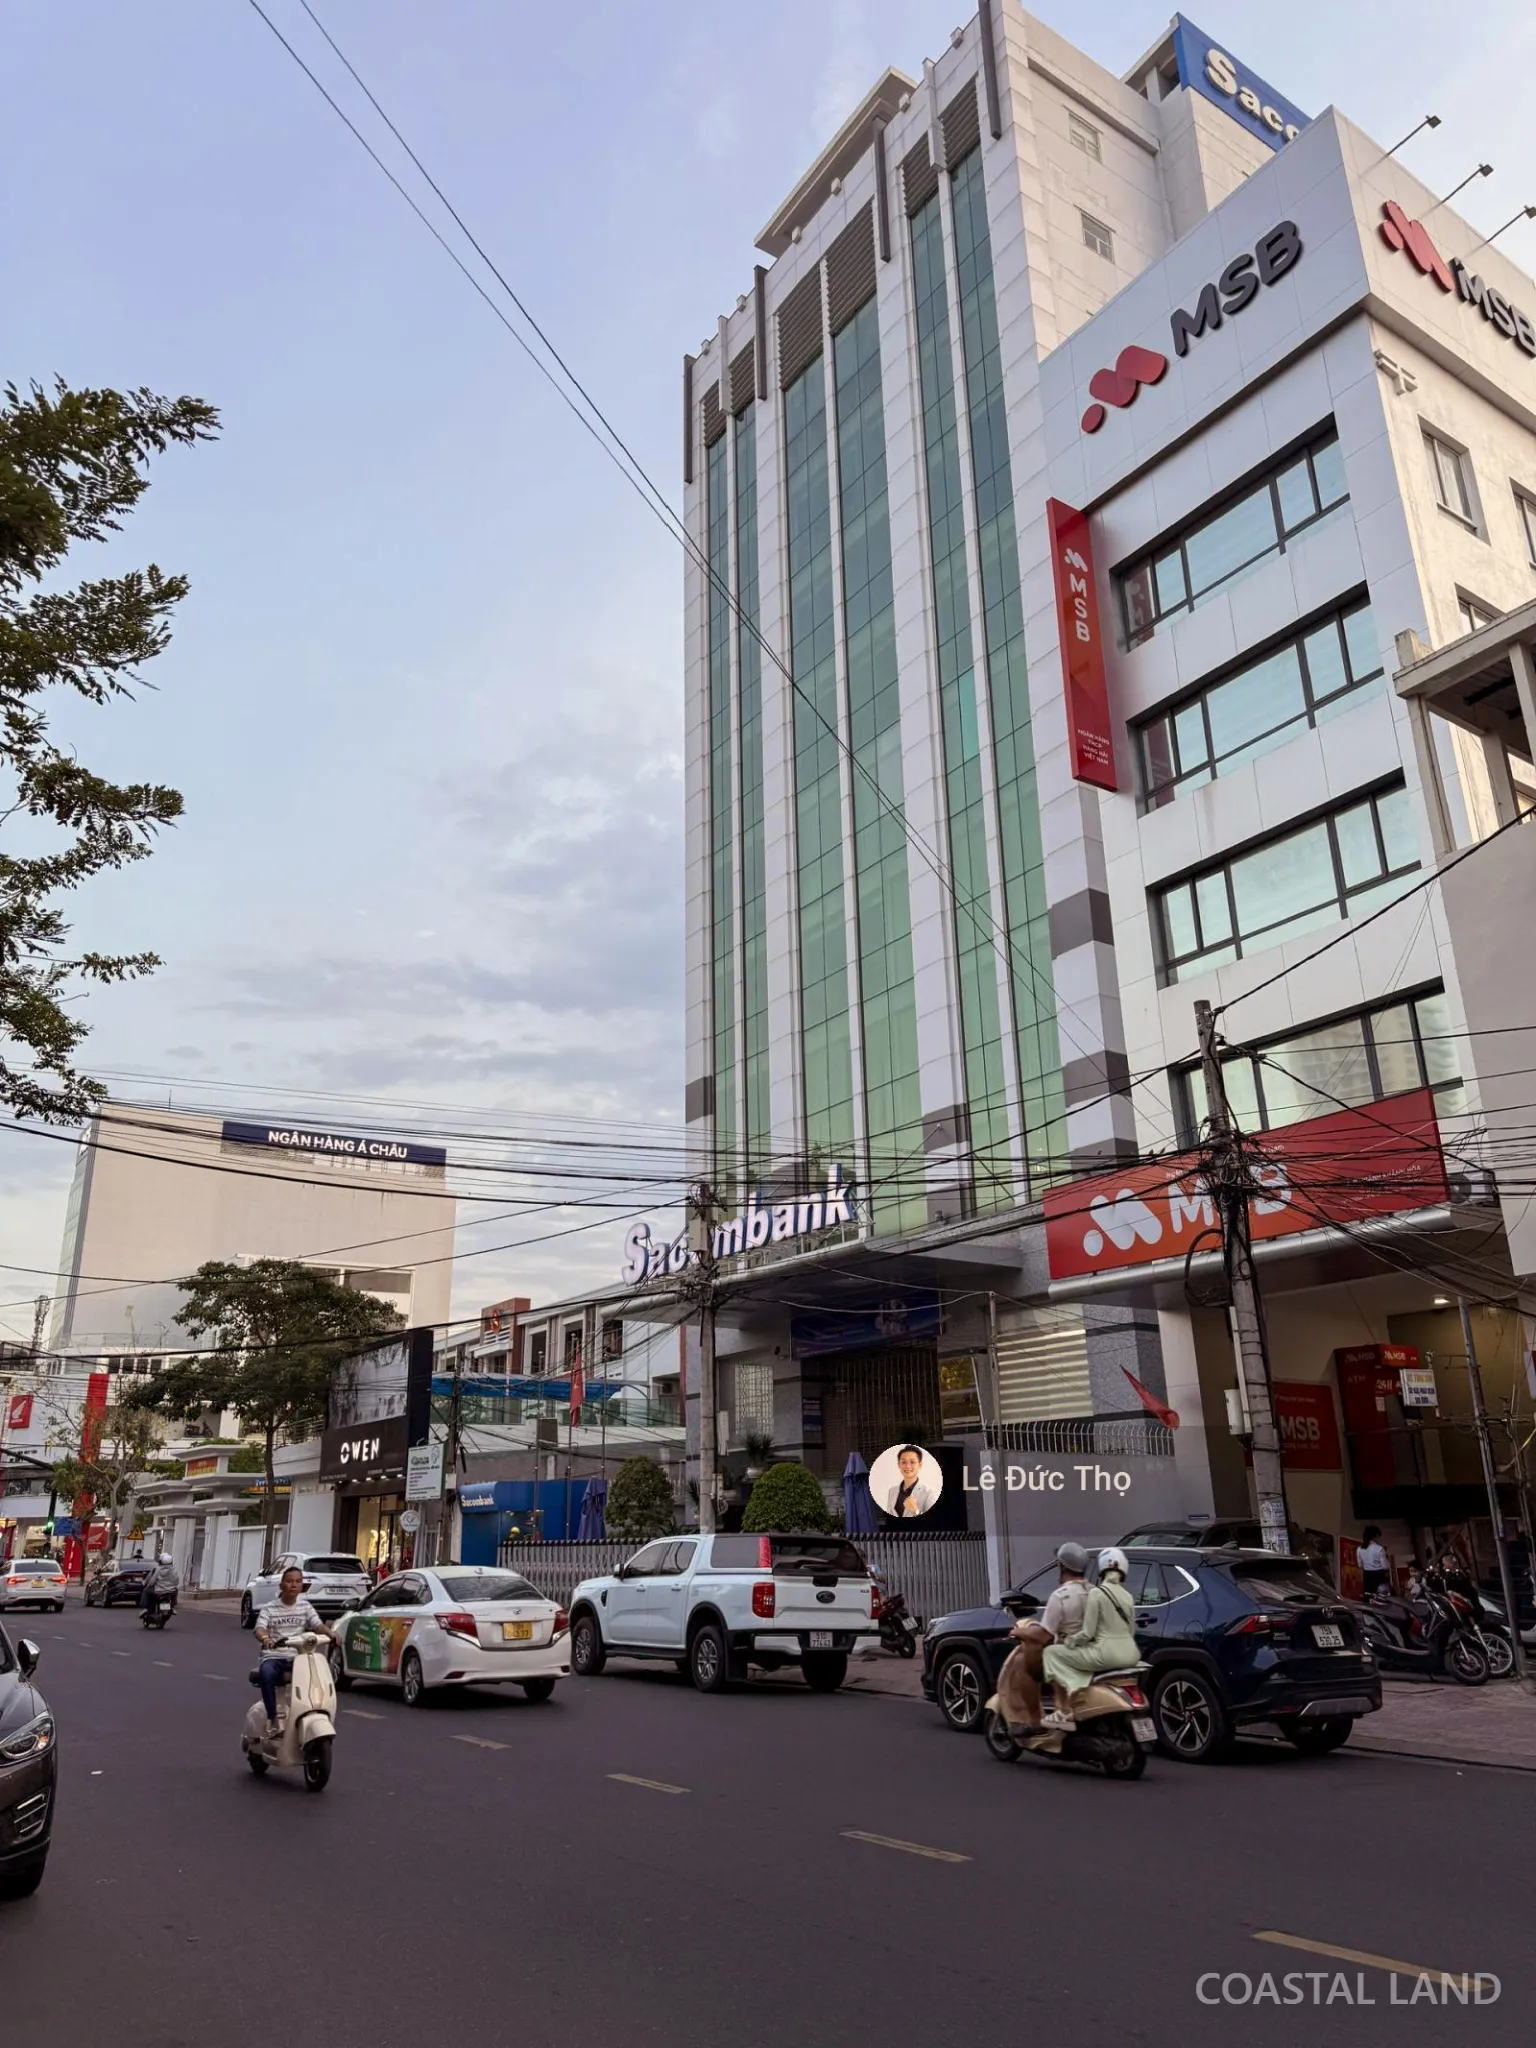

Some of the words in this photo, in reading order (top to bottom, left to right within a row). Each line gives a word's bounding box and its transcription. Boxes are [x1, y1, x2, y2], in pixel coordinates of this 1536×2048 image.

[1170, 220, 1304, 357] MSB
[1448, 256, 1536, 358] MSB
[1069, 573, 1091, 642] MSB
[267, 1130, 312, 1147] NGÂN
[313, 1134, 355, 1152] HÀNG
[356, 1139, 368, 1154] Á
[369, 1143, 408, 1159] CHÂU
[621, 1163, 856, 1287] Sacmbank
[1168, 1162, 1292, 1234] MB
[340, 1437, 380, 1464] OWEN
[1280, 1415, 1320, 1441] MSB
[461, 1493, 494, 1507] Sacombank
